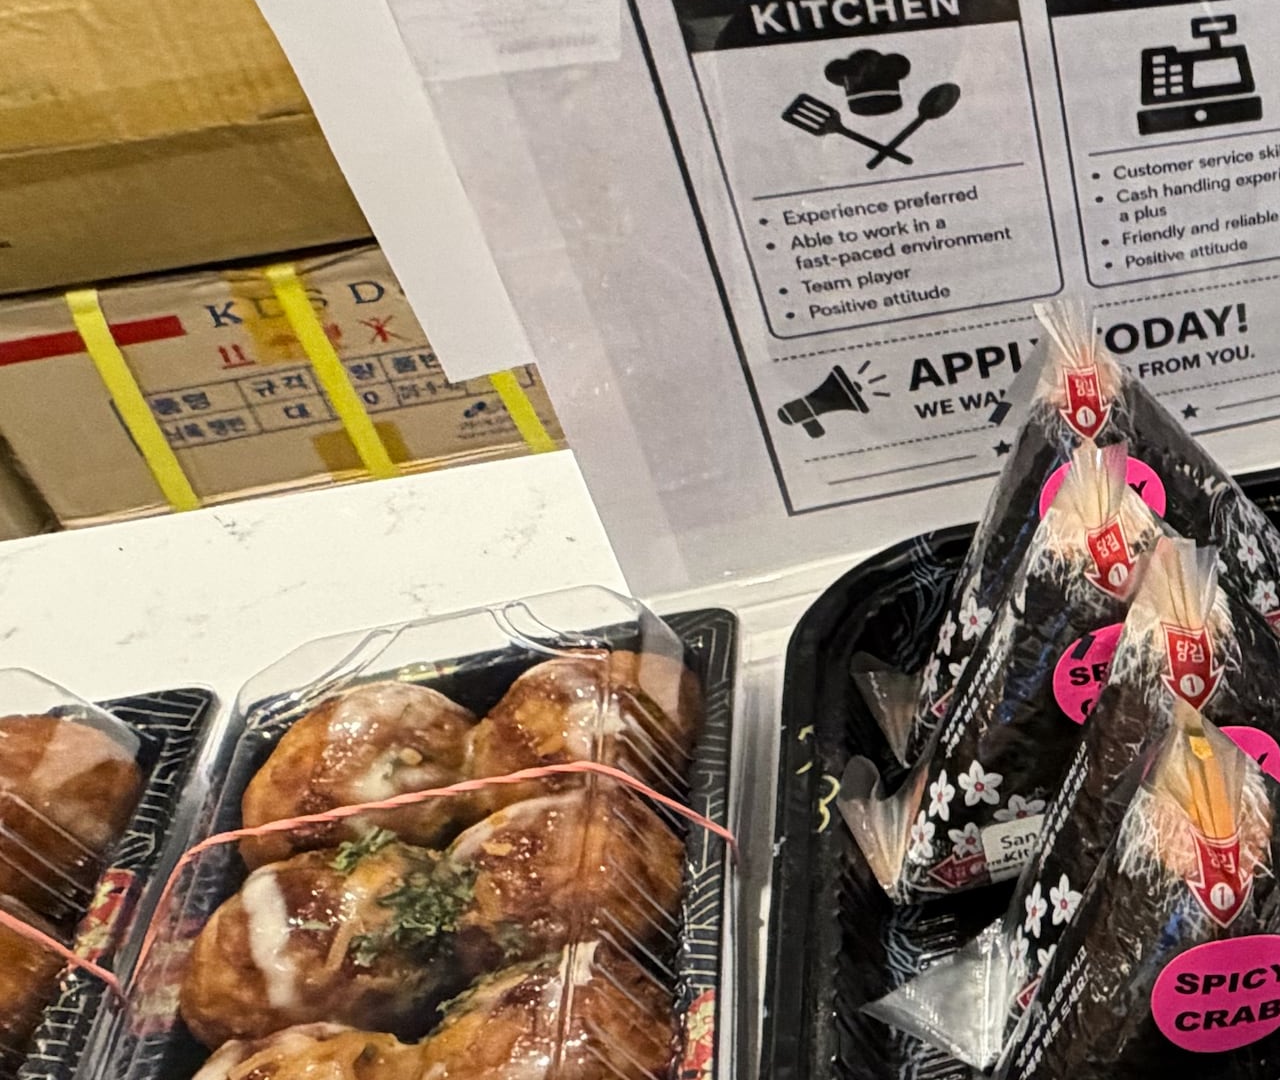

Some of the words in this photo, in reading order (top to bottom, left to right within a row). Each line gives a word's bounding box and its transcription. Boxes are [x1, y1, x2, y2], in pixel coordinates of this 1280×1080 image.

[1112, 157, 1194, 181] Customer
[1198, 149, 1255, 169] service
[782, 201, 889, 228] Experience
[894, 184, 979, 214] preferred
[1116, 185, 1158, 204] Cash
[1163, 173, 1231, 198] handling
[1119, 210, 1131, 222] a
[1134, 204, 1168, 224] plus
[1121, 223, 1186, 247] Friendly
[1190, 218, 1220, 236] and
[1224, 209, 1280, 231] reliable
[790, 230, 834, 251] Able
[838, 227, 859, 245] to
[862, 222, 910, 242] work
[913, 218, 931, 235] in
[935, 217, 947, 231] a
[795, 242, 897, 271] fast-paced
[900, 226, 1013, 255] environment
[1125, 248, 1185, 269] Positive
[1189, 238, 1249, 259] attitude
[800, 276, 853, 295] Team
[857, 265, 912, 290] player
[808, 296, 878, 320] Positive
[882, 283, 951, 308] attitude
[908, 336, 1040, 392] APPL
[1096, 301, 1248, 355] ODAY!
[914, 402, 954, 420] WE
[959, 388, 1006, 412] WA
[1139, 356, 1201, 380] FROM
[1205, 343, 1256, 368] YOU.
